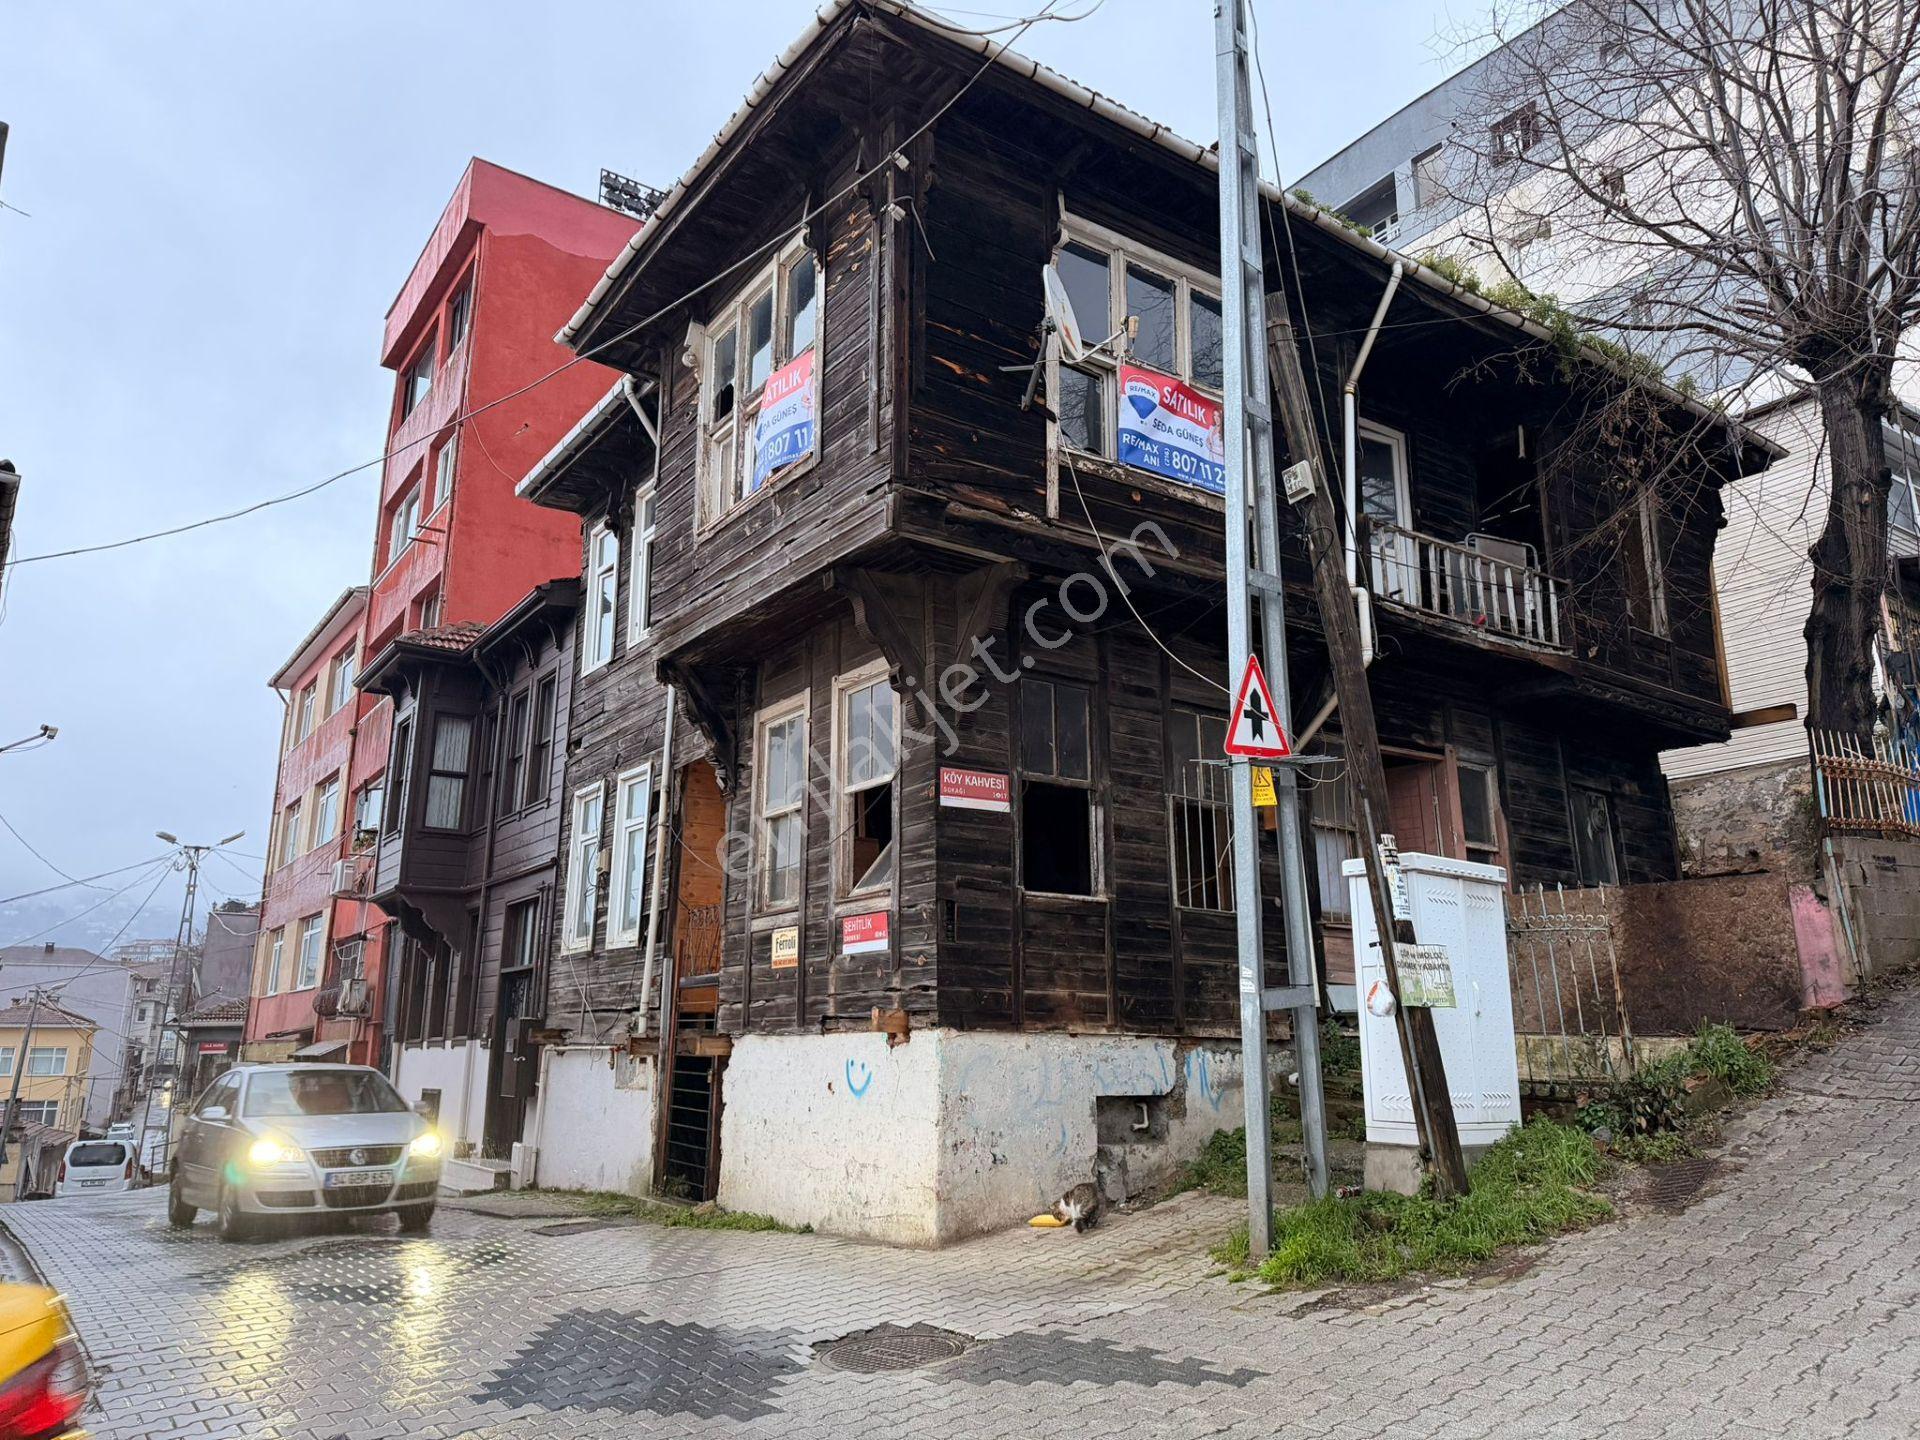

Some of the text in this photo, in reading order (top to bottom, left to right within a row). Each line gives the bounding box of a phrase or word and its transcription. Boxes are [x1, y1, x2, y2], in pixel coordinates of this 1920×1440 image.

[1129, 384, 1157, 399] RE/MAX
[771, 404, 798, 426] GÜNEŞ
[1163, 386, 1207, 425] SATILIK
[768, 432, 790, 456] 807
[795, 426, 808, 449] 11
[1122, 433, 1159, 455] RE/MAX
[1152, 418, 1204, 448] SEDA GÜNEŞ
[1143, 454, 1160, 467] ANI
[1172, 451, 1226, 485] 807 11 2
[943, 771, 1006, 790] KÖY KAHVESİ
[843, 917, 872, 934] ŞEHİTLİK
